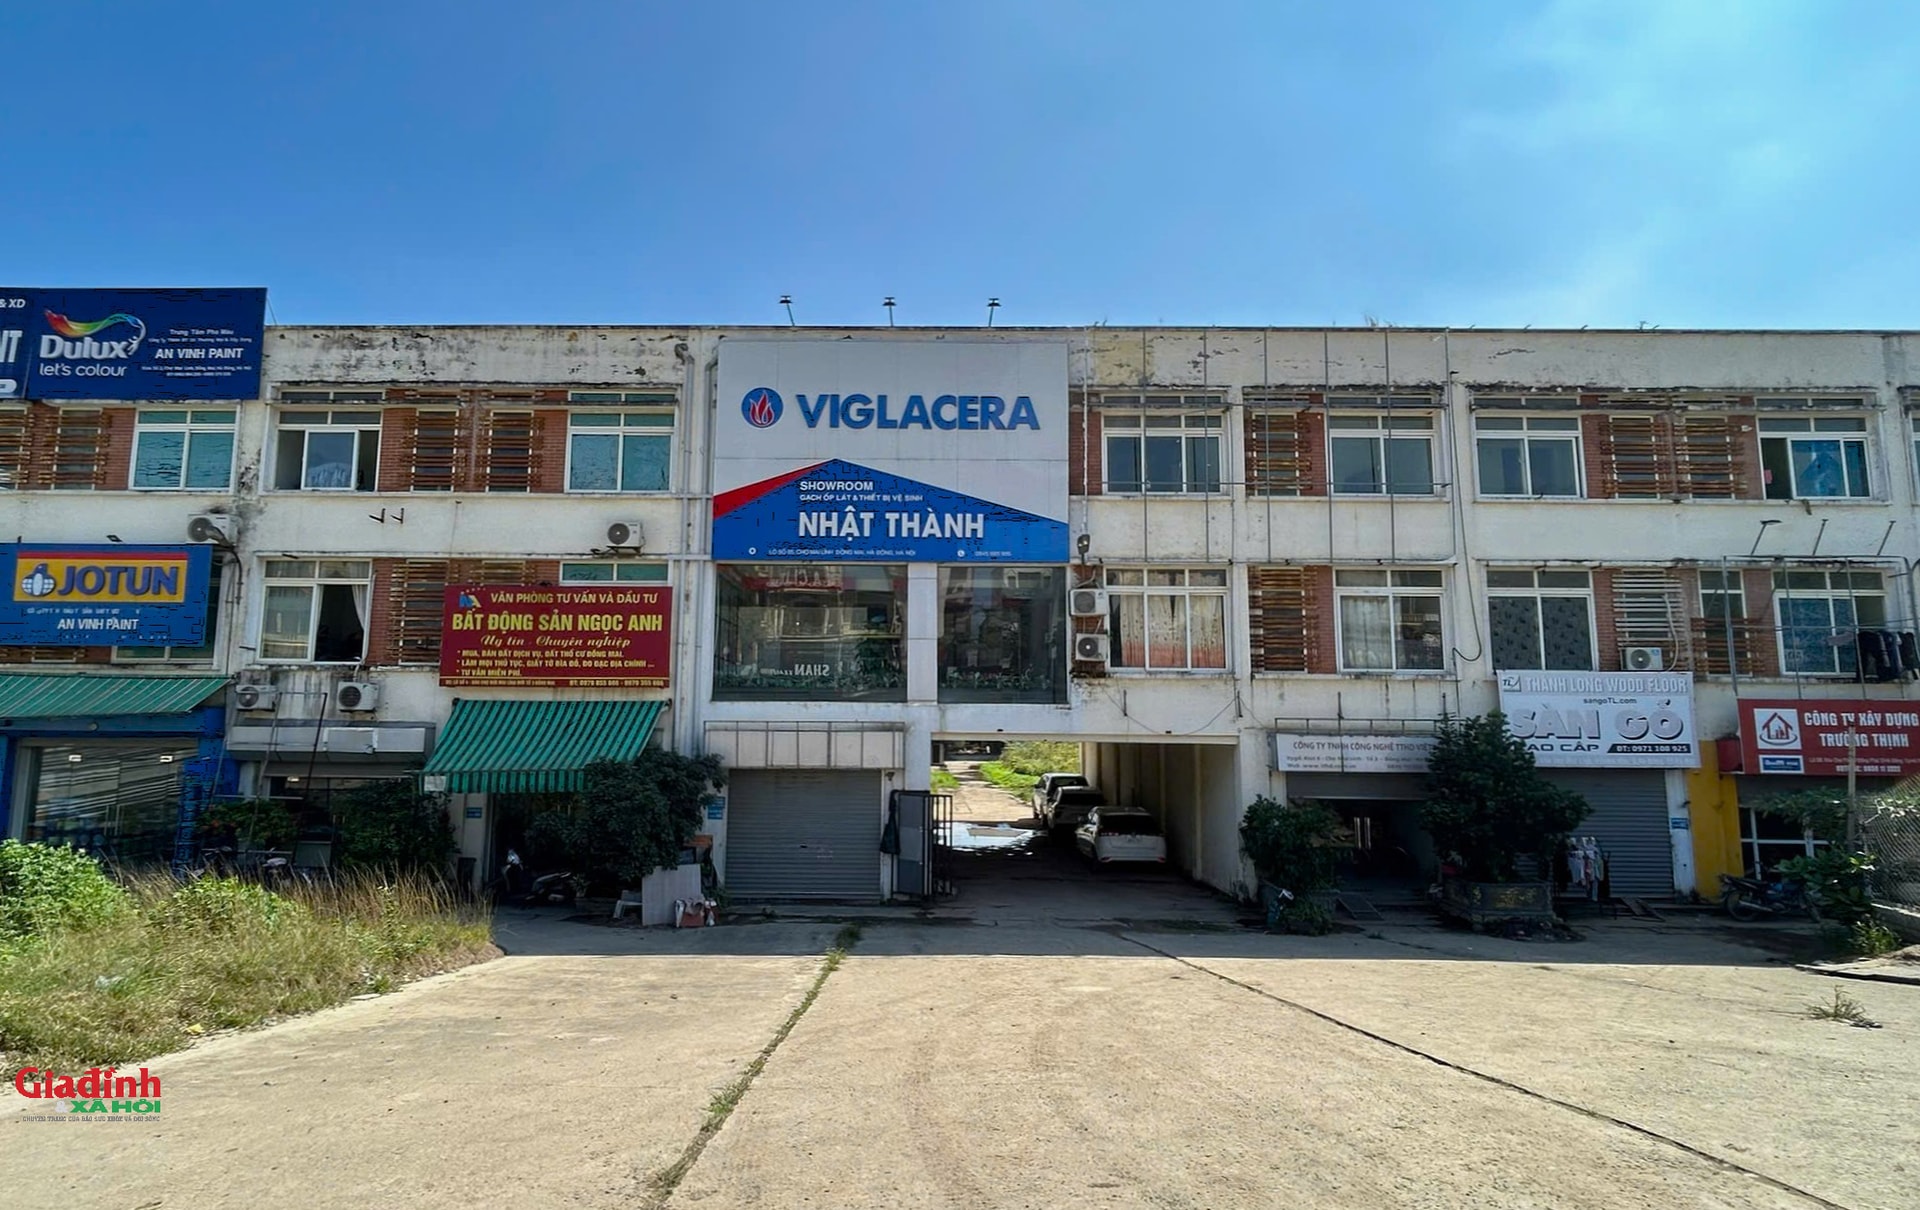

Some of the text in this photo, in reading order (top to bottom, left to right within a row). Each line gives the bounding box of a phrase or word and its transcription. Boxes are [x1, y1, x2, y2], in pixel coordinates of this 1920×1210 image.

[8, 299, 26, 308] XD
[40, 335, 129, 359] Dulux
[155, 348, 244, 359] AN VINH PAINT
[40, 363, 127, 377] let's colour
[796, 394, 1041, 430] VIGLACERA
[800, 481, 873, 491] SHOWROOM
[799, 505, 984, 541] NHẬT THÀNH
[57, 566, 178, 596] JOTUN
[491, 591, 513, 603] VĂN
[516, 591, 553, 603] PHÒNG
[557, 593, 571, 603] TƯ
[573, 590, 596, 603] VẤN
[599, 591, 614, 603] VÀ
[643, 592, 658, 603] TƯ
[57, 619, 74, 629] AN
[78, 619, 104, 629] VINH
[452, 608, 663, 635] BẤT ĐỘNG SẢN NGỌC ANH
[481, 635, 502, 647] Uy
[507, 636, 524, 646] tín
[536, 635, 583, 648] Chuyên
[587, 636, 631, 648] nghiệp
[1572, 679, 1603, 692] LONG
[1606, 679, 1644, 692] WOOD
[1649, 679, 1688, 693] FLOOR
[1510, 699, 1684, 740] SÀN GỖ
[1804, 710, 1919, 729] CÔNG TY XÂY DỰNG
[1293, 741, 1315, 750] CÔNG
[1316, 742, 1325, 750] TY
[1328, 742, 1349, 750] TNHH
[1350, 742, 1372, 750] CÔNG
[1373, 741, 1394, 751] NGHỆ
[1525, 743, 1554, 752] AO
[1872, 733, 1909, 750] THỊNH
